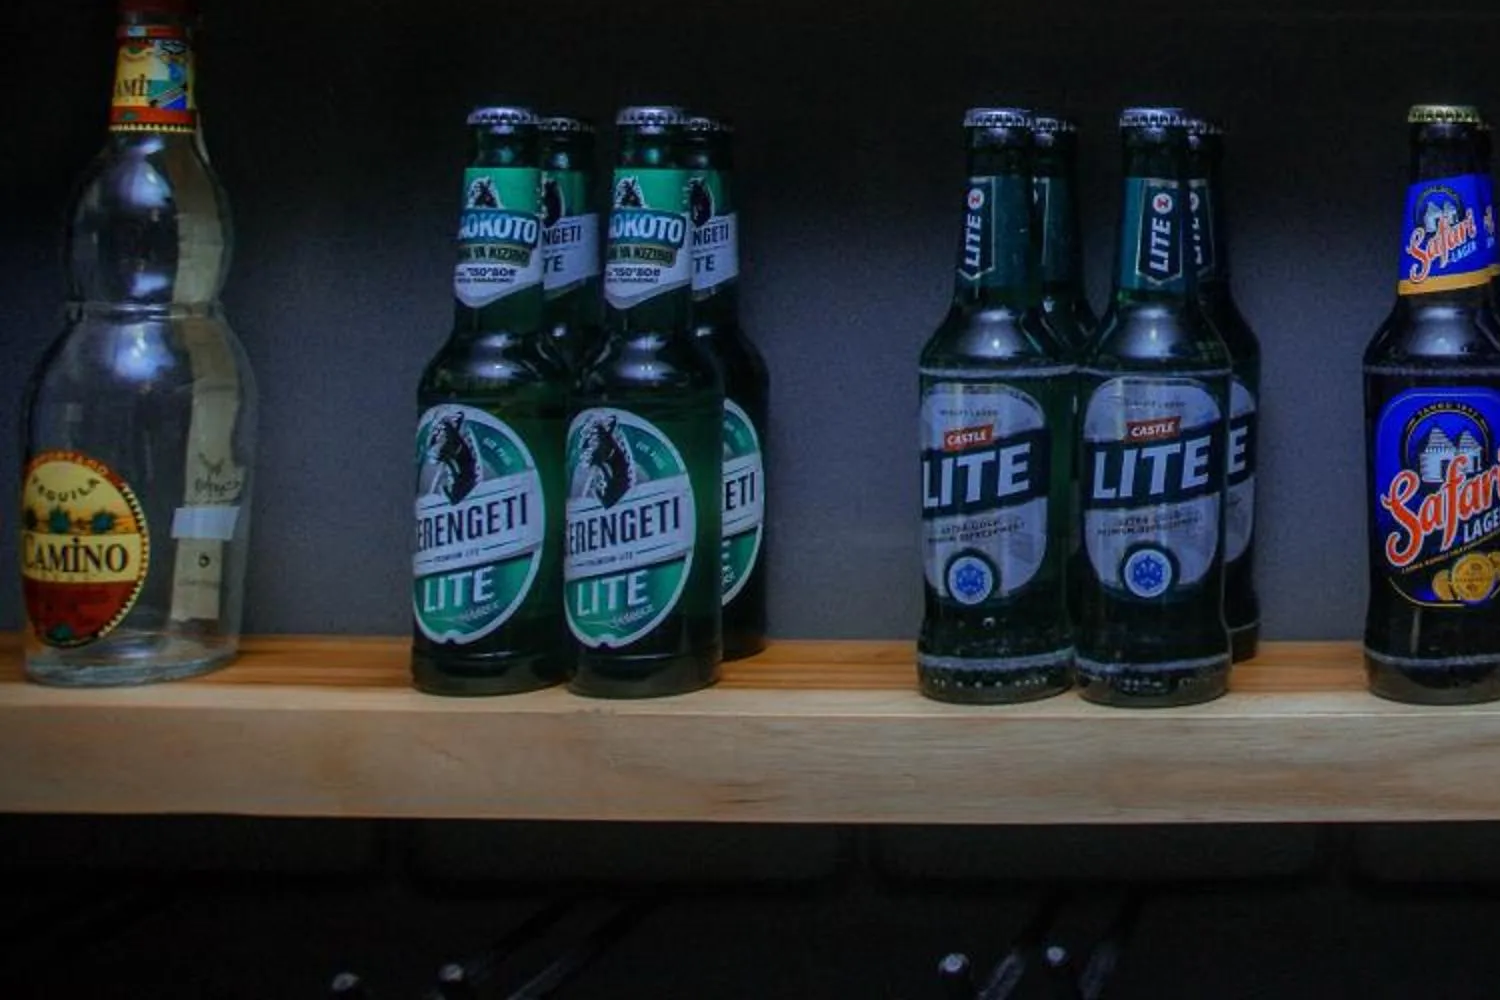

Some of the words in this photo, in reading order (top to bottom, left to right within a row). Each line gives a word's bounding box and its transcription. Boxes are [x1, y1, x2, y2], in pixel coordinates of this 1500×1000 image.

[542, 225, 581, 246] NGETI
[692, 224, 729, 247] NGETI
[964, 213, 983, 268] LITE
[1148, 216, 1172, 274] LITE
[1405, 206, 1478, 285] Safari
[946, 429, 988, 447] CASTLE
[1130, 421, 1175, 438] CASTLE
[923, 441, 1031, 508] LITE
[1093, 435, 1212, 500] LITE
[418, 492, 529, 552] ERENGETI
[569, 496, 680, 555] ERENGETI
[423, 567, 495, 613] LITE
[577, 570, 648, 618] LITE
